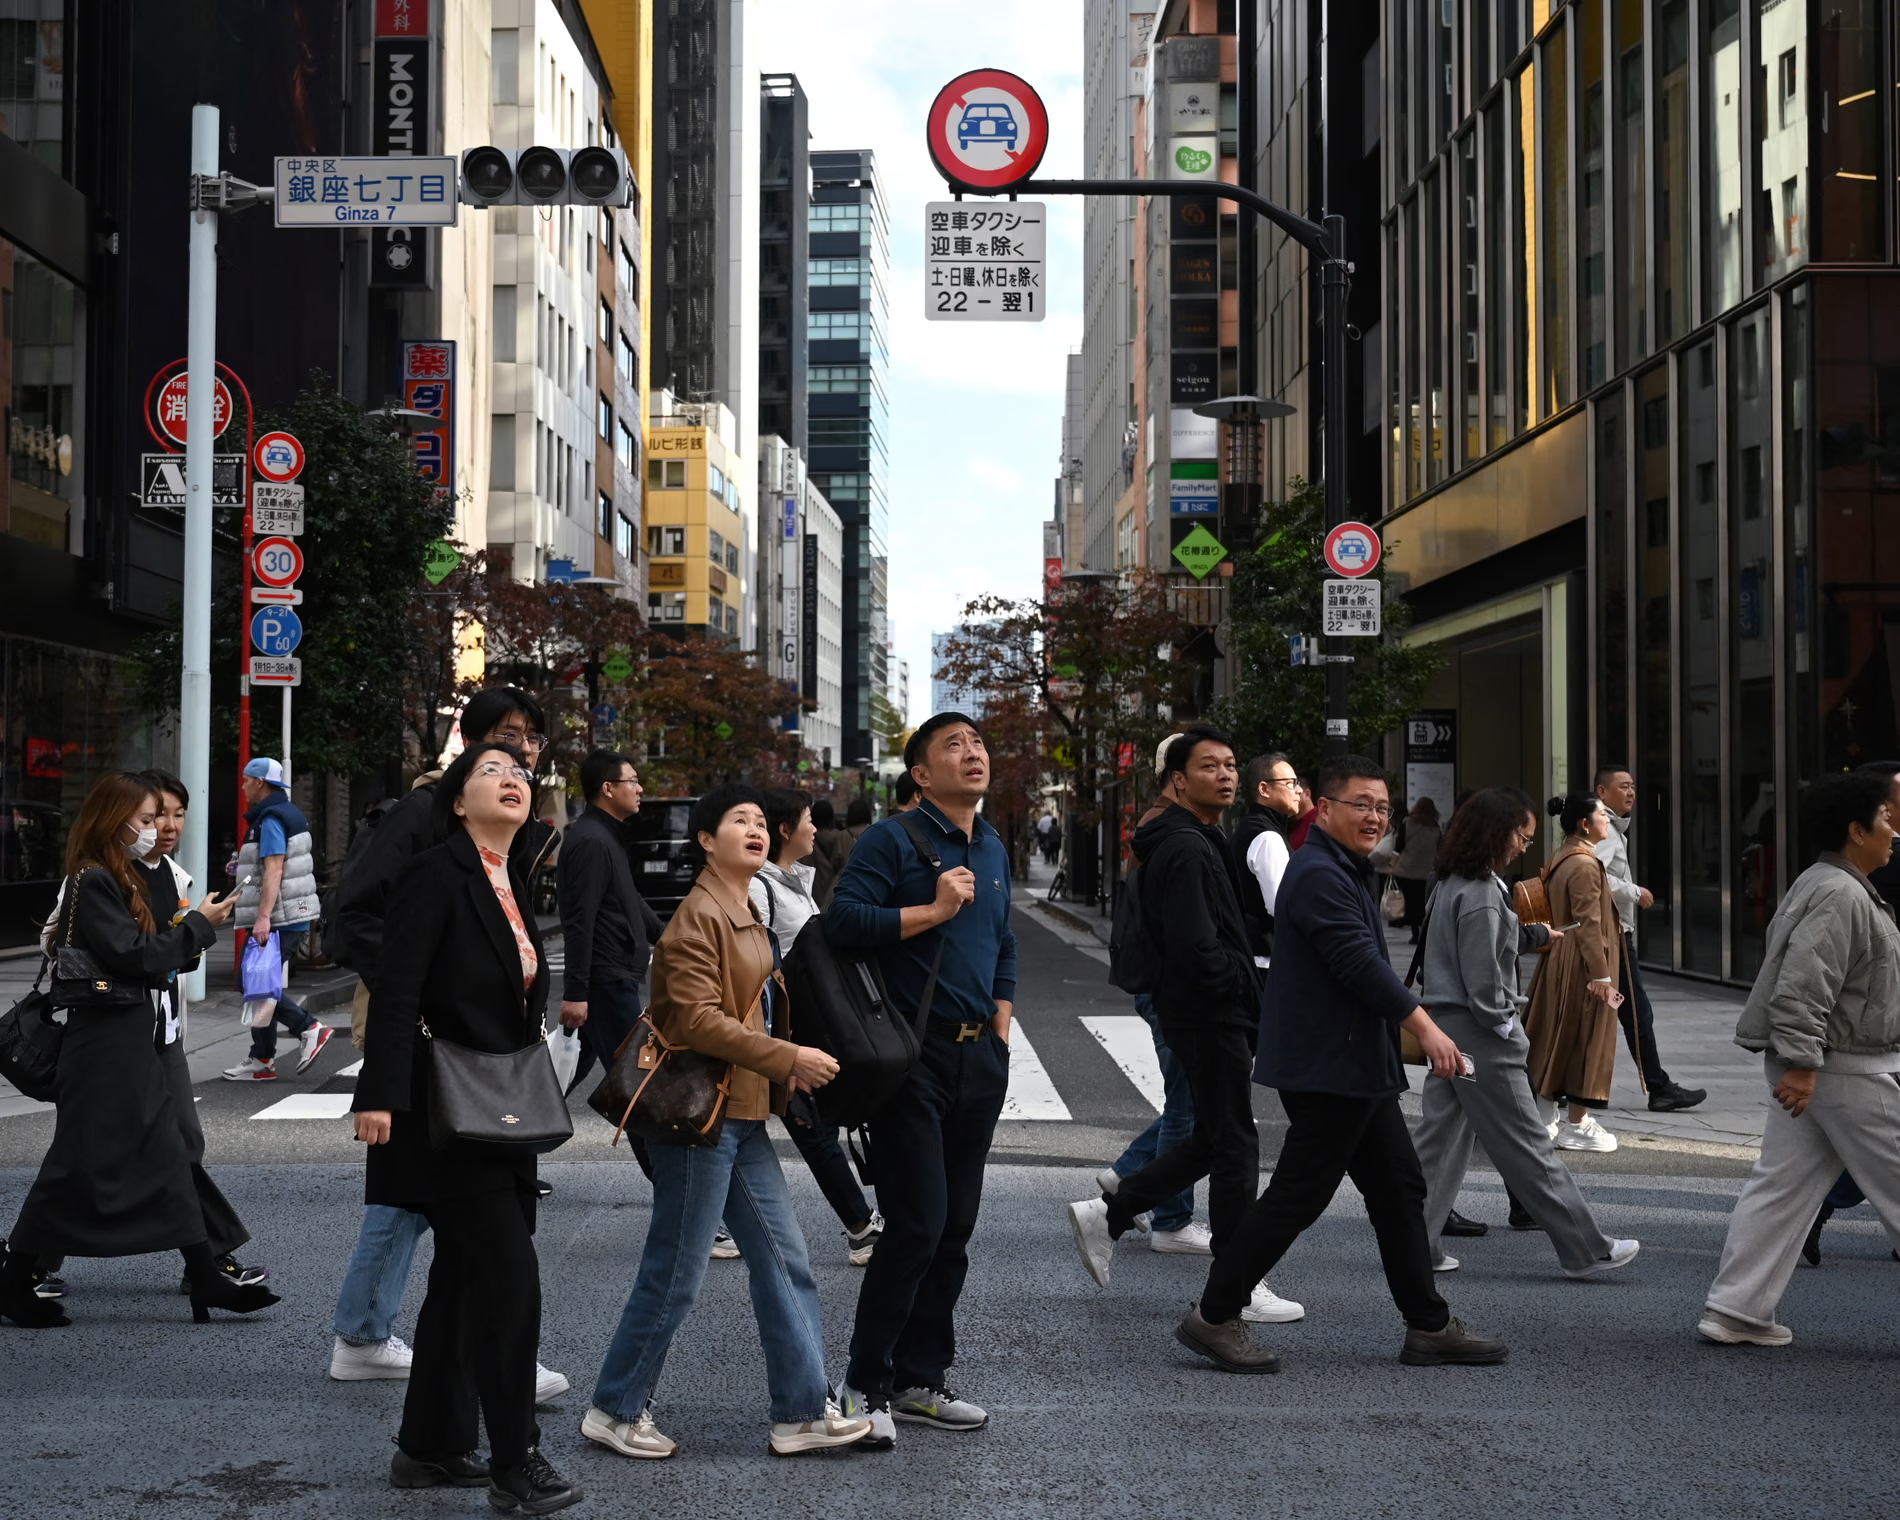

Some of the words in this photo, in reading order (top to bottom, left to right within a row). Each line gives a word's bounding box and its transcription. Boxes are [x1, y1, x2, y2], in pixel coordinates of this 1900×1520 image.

[388, 54, 414, 241] MONTC
[288, 159, 337, 173] 中央区
[288, 174, 444, 203] 銀座七丁目
[335, 206, 379, 220] Ginza
[386, 206, 396, 220] 7
[931, 211, 1040, 231] 空車タクシー
[931, 236, 1024, 256] 迎車を除く
[931, 267, 1039, 287] 土・日曜、休日を除く
[937, 291, 968, 312] 22
[1176, 376, 1210, 384] seigou
[166, 394, 226, 422] 消栓
[257, 488, 300, 498] 空車タクシー
[1172, 484, 1216, 493] FamilyMart
[260, 521, 275, 530] 22
[806, 539, 814, 574] HOTEL
[1181, 546, 1219, 556] 花椿通り
[265, 551, 292, 573] 30
[1328, 585, 1375, 595] 空車タクシー
[1328, 595, 1374, 606] 迎車を除く
[267, 609, 288, 617] 9-21
[1328, 621, 1343, 631] 22
[262, 619, 282, 650] P
[275, 637, 290, 650] 60
[785, 643, 795, 663] G
